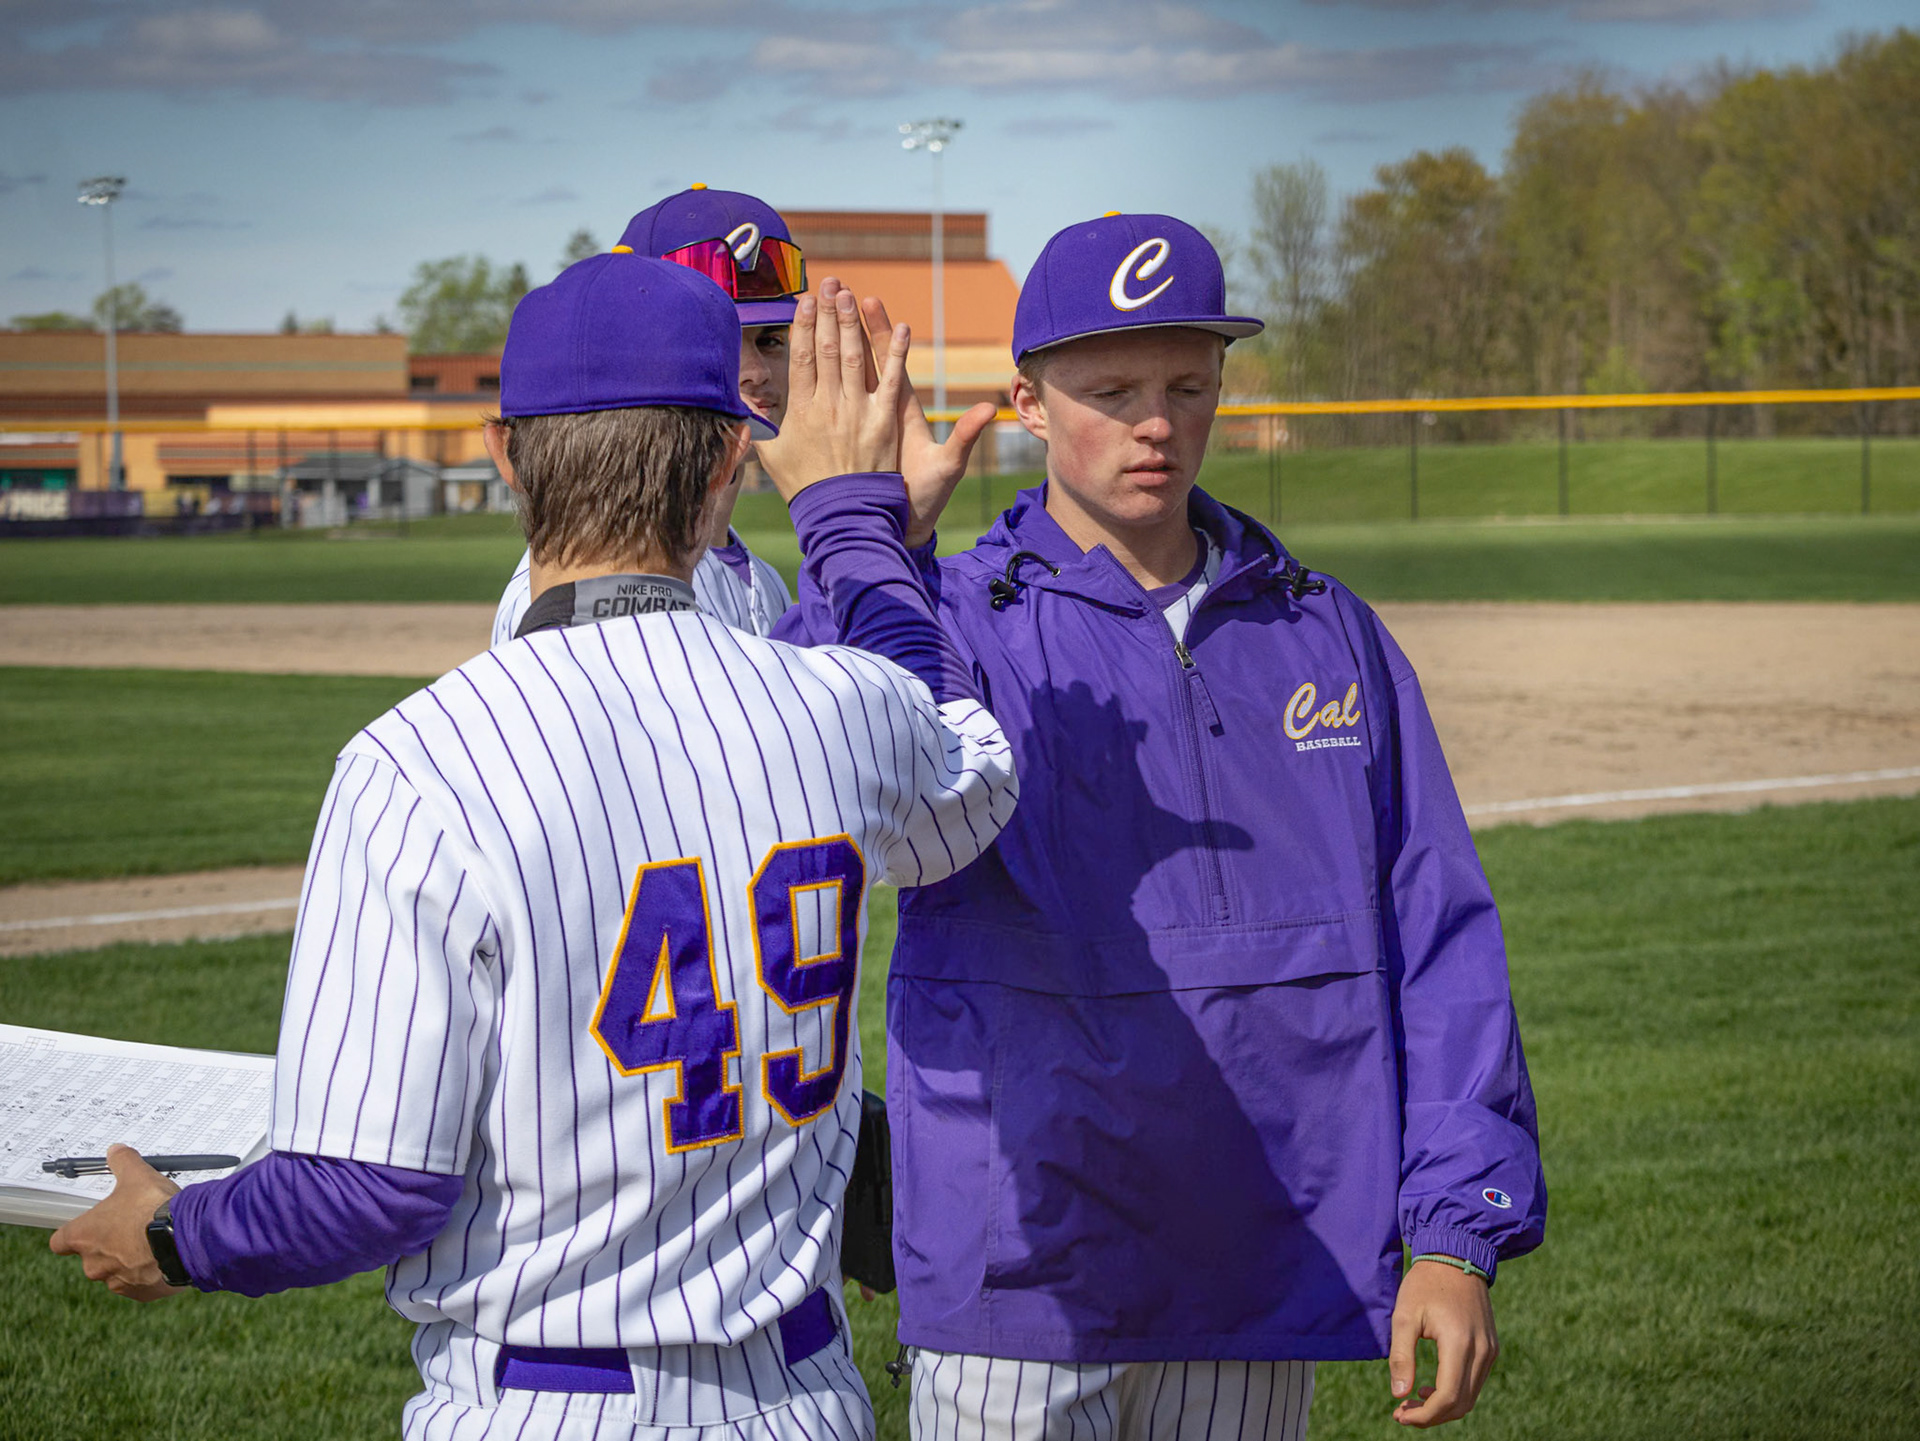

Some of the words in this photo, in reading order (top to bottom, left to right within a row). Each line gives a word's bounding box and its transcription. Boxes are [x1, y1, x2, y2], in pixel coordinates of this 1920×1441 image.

[1109, 237, 1174, 312] C
[617, 584, 648, 596] NIKE
[650, 585, 673, 598] PRO
[1283, 682, 1361, 740] Cal
[1295, 736, 1361, 752] BASEBALL
[589, 832, 866, 1155] 49
